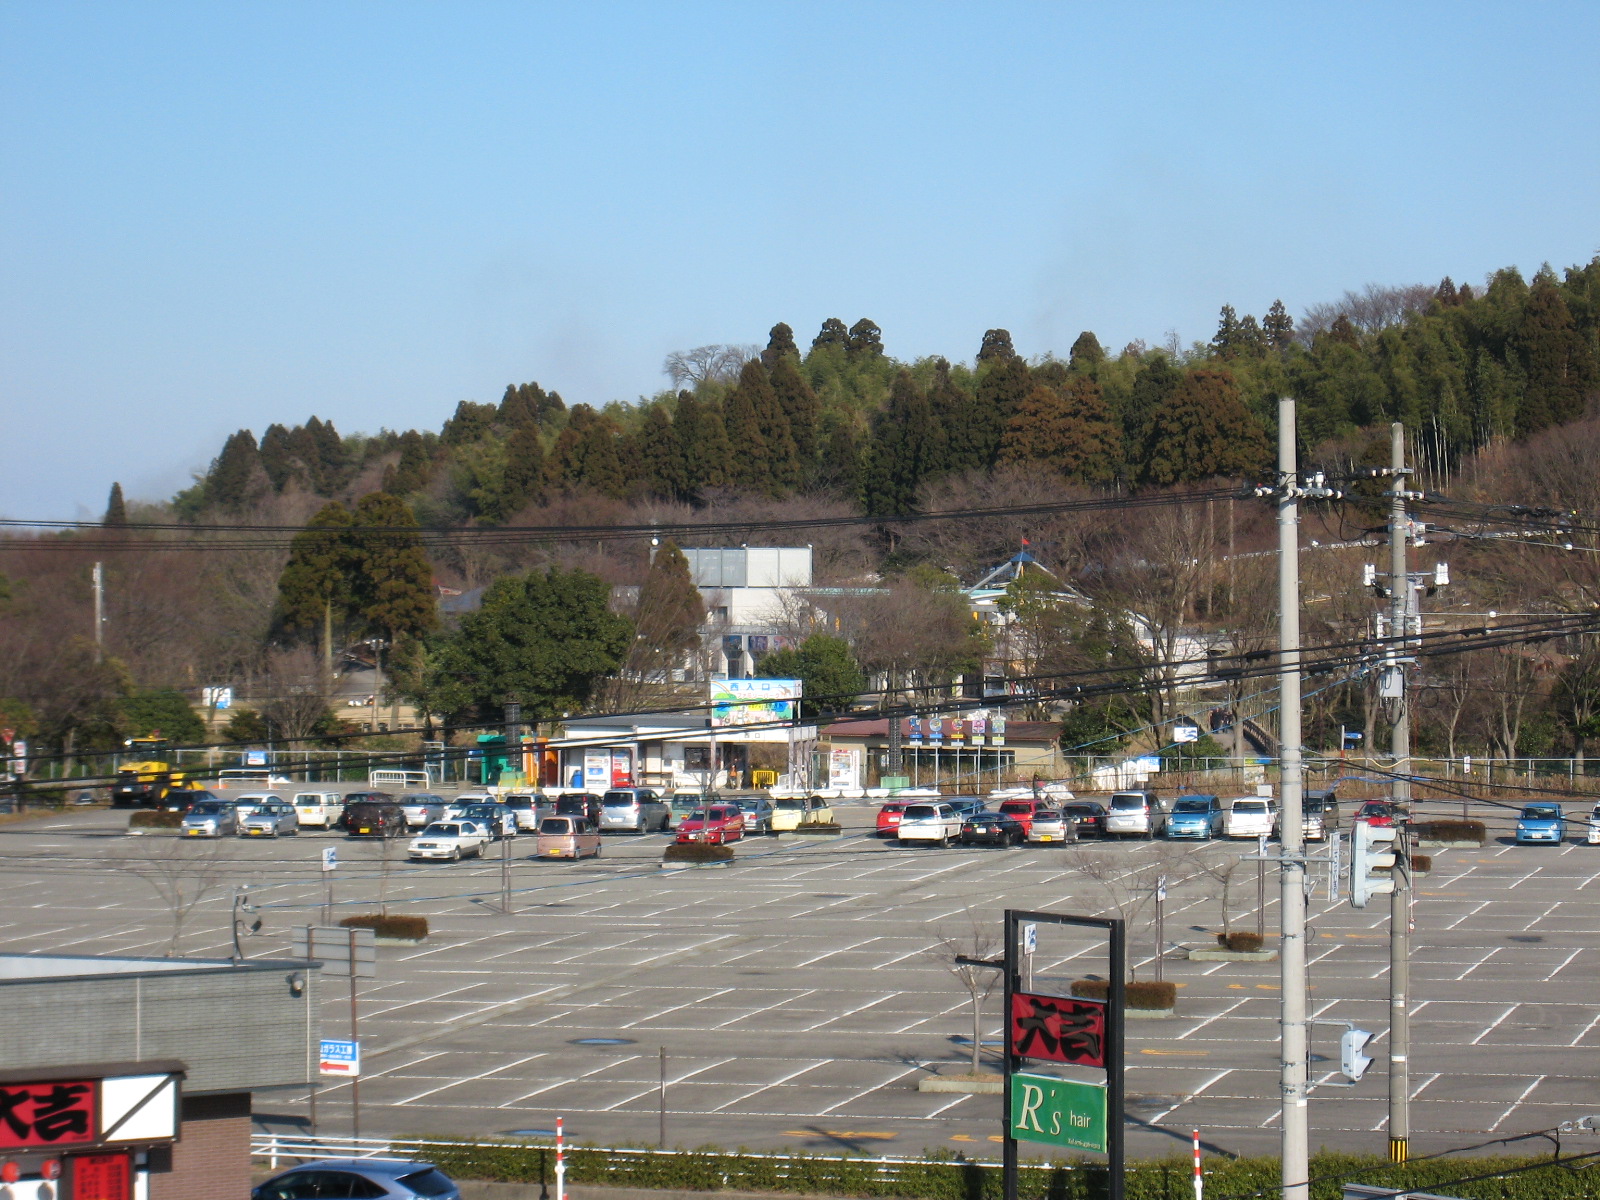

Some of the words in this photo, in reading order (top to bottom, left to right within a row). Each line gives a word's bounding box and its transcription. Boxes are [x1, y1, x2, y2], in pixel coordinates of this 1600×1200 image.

[730, 682, 771, 692] 西入口
[1070, 1110, 1092, 1128] hair
